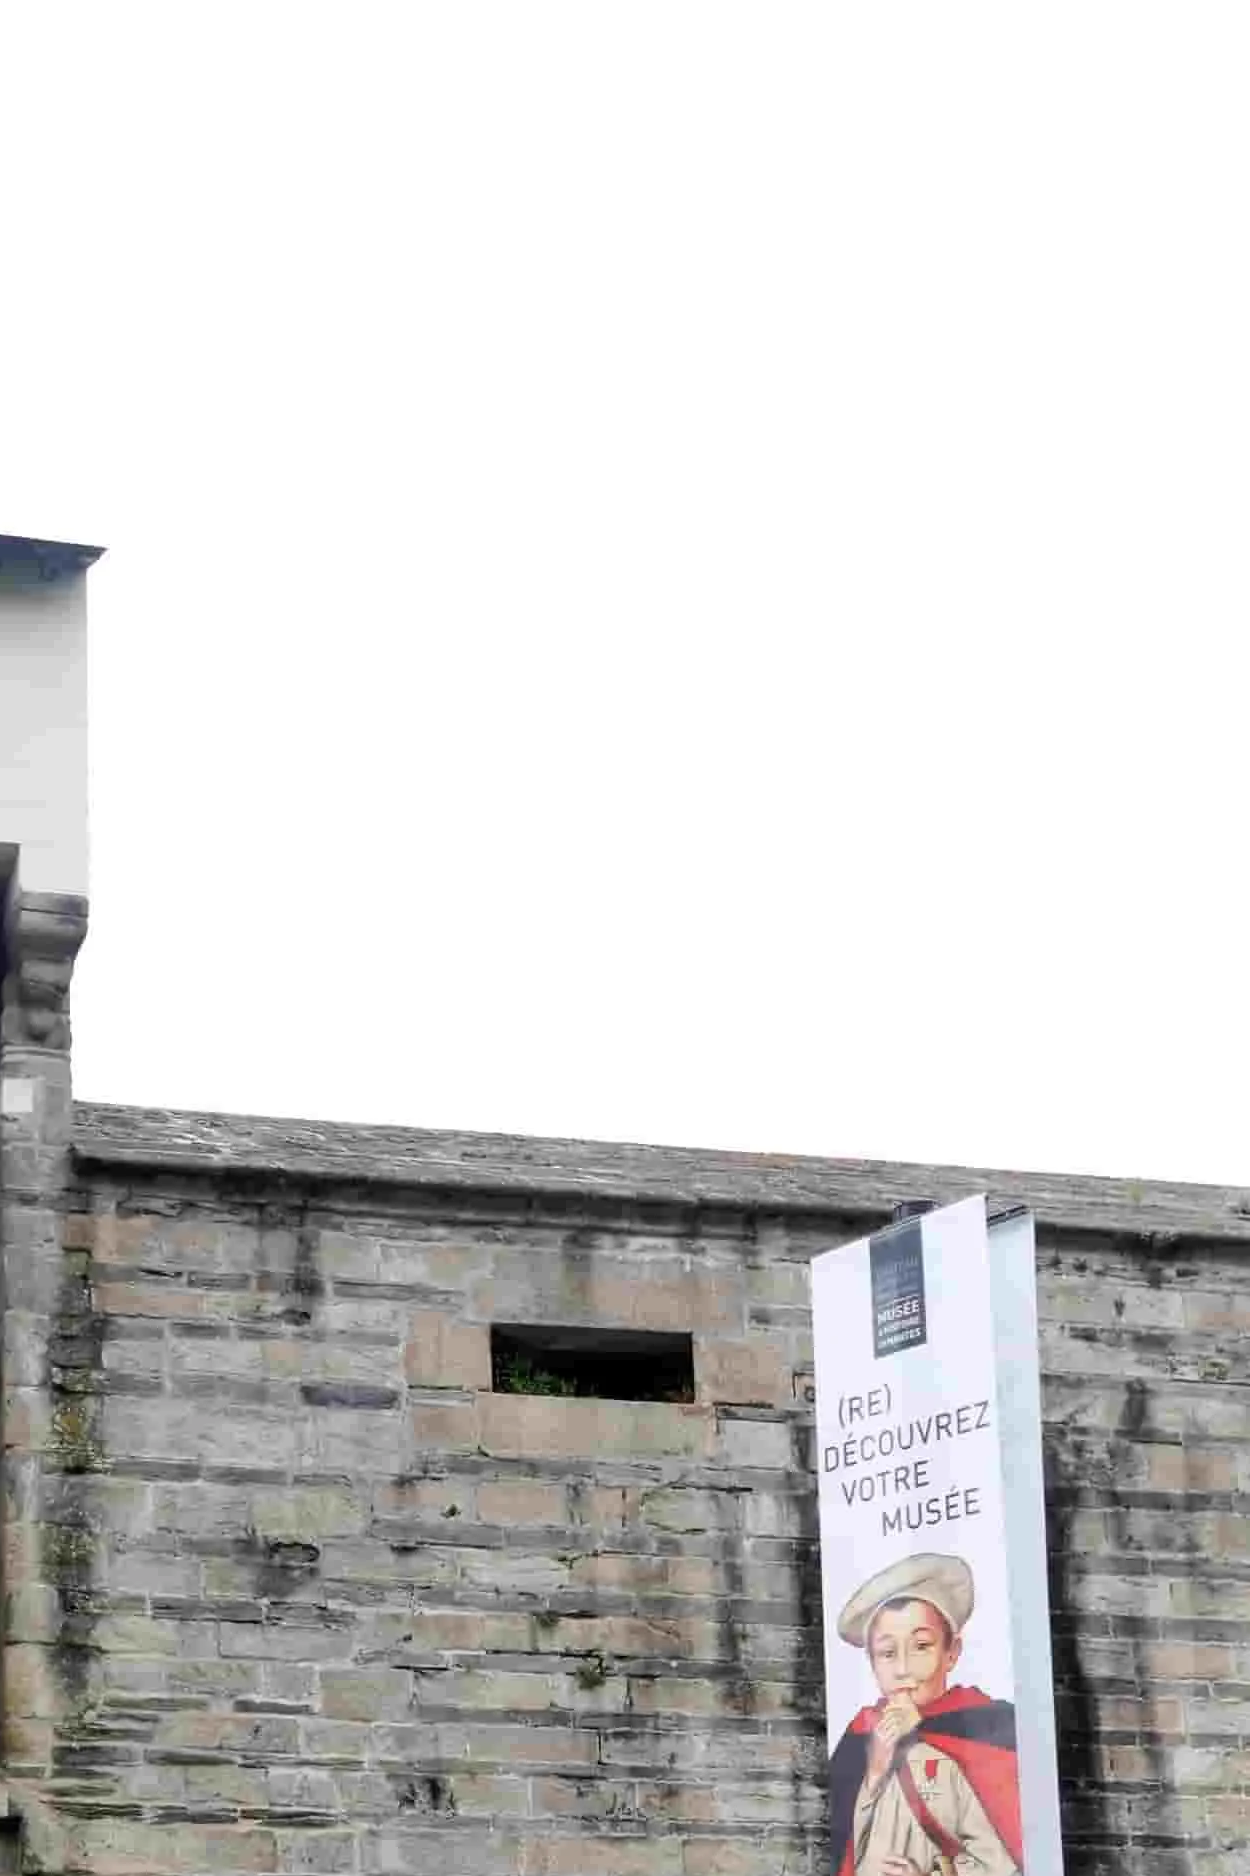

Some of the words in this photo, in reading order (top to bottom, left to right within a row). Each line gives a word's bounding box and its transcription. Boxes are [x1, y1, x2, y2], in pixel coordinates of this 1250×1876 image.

[838, 1383, 891, 1428] (RE)
[824, 1400, 990, 1472] DÉCOUVREZ
[841, 1460, 930, 1507] VOTRE
[882, 1485, 981, 1537] MUSÉE
